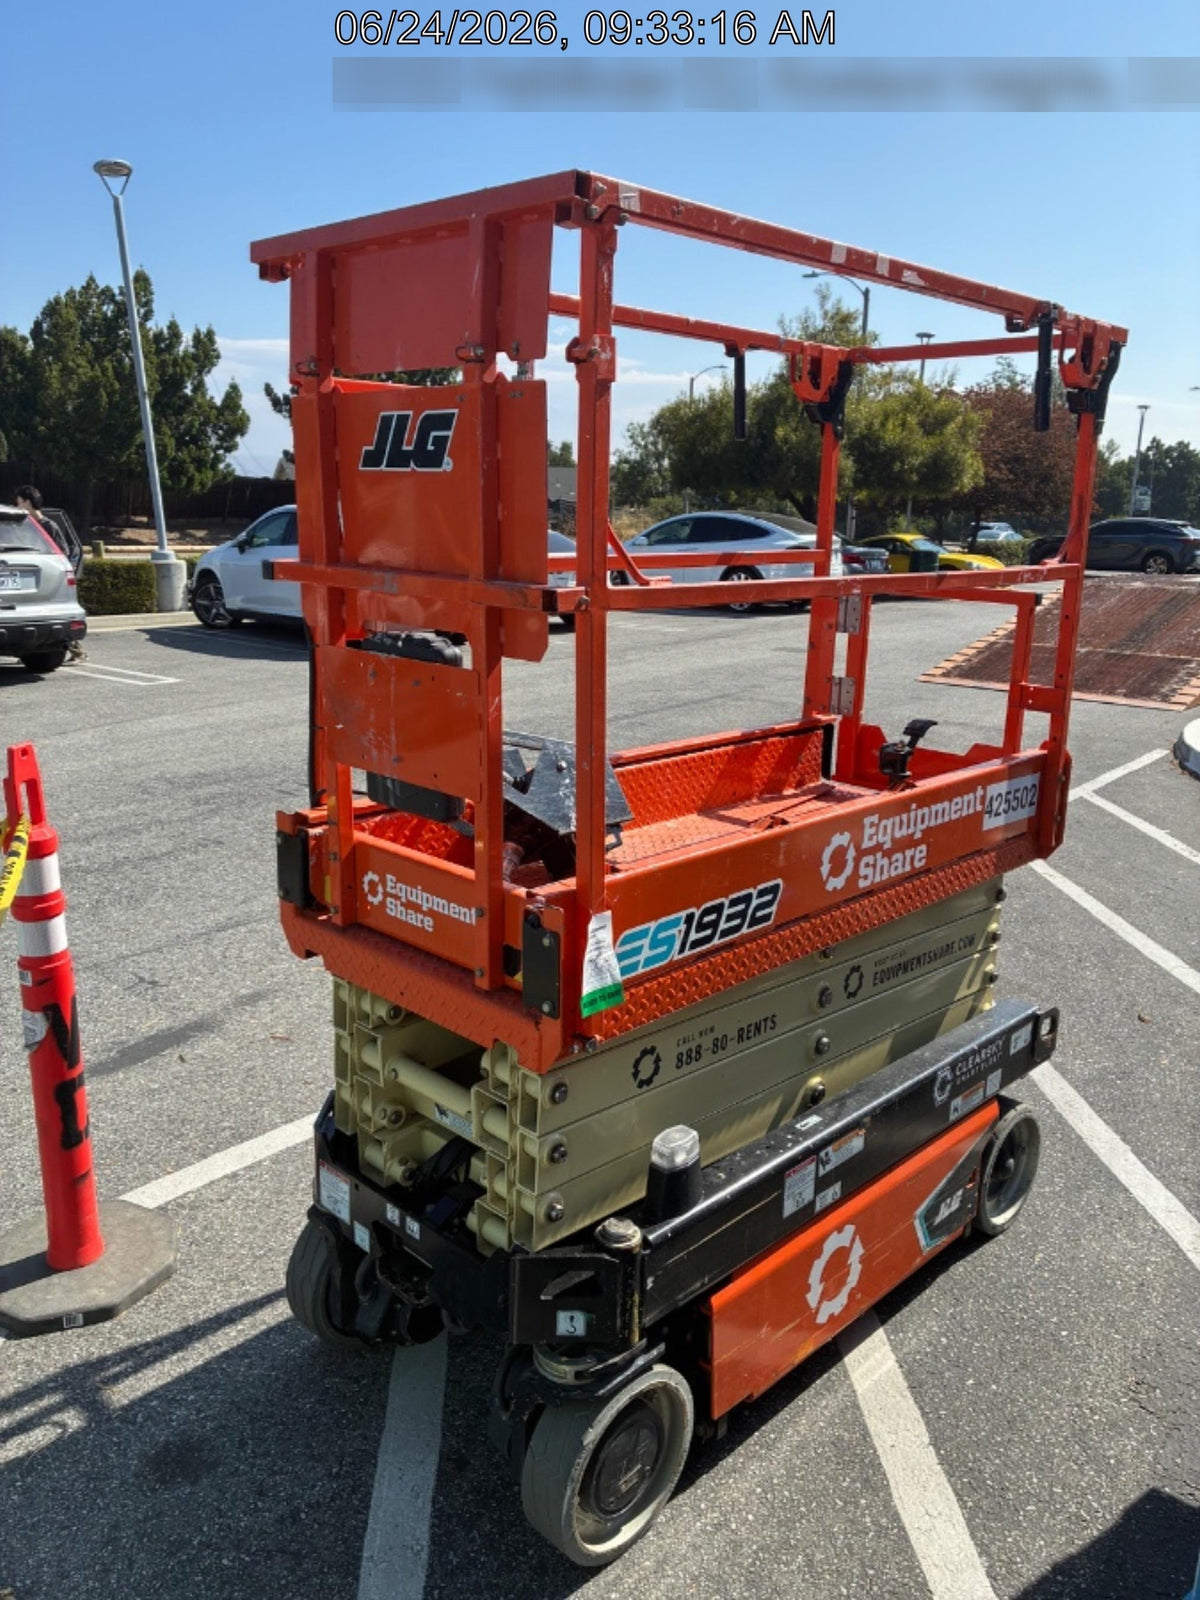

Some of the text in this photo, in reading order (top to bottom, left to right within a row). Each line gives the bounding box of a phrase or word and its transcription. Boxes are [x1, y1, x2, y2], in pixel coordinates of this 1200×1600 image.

[359, 409, 459, 472] JLG
[861, 784, 984, 850] Equipment
[984, 783, 1037, 819] 425502
[858, 844, 927, 889] Share
[385, 873, 477, 926] Equipment
[385, 897, 434, 932] Share
[614, 878, 783, 980] ES1932
[675, 1014, 778, 1070] 888-80-RENTS
